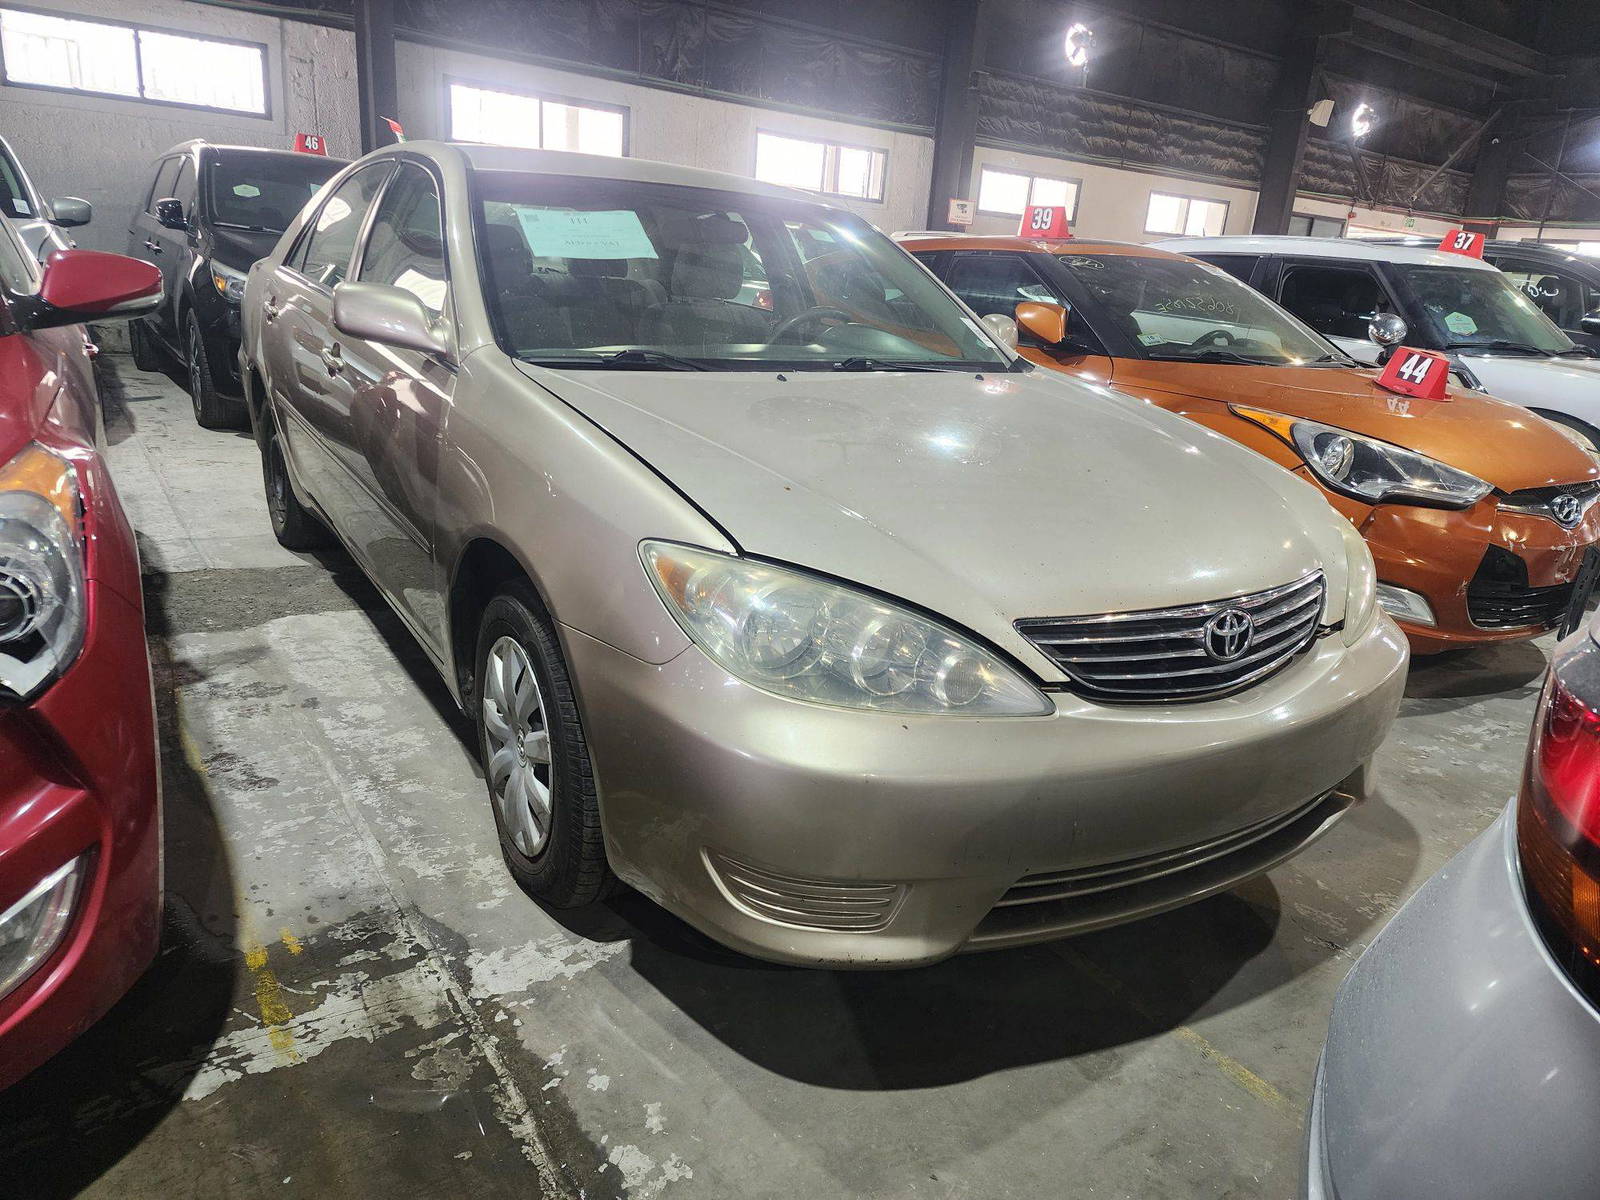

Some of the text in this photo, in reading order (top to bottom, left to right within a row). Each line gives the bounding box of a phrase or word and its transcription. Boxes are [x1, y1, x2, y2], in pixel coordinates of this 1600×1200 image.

[305, 135, 319, 150] 46
[1031, 207, 1053, 230] 39
[1454, 231, 1476, 250] 37
[1400, 354, 1434, 385] 44
